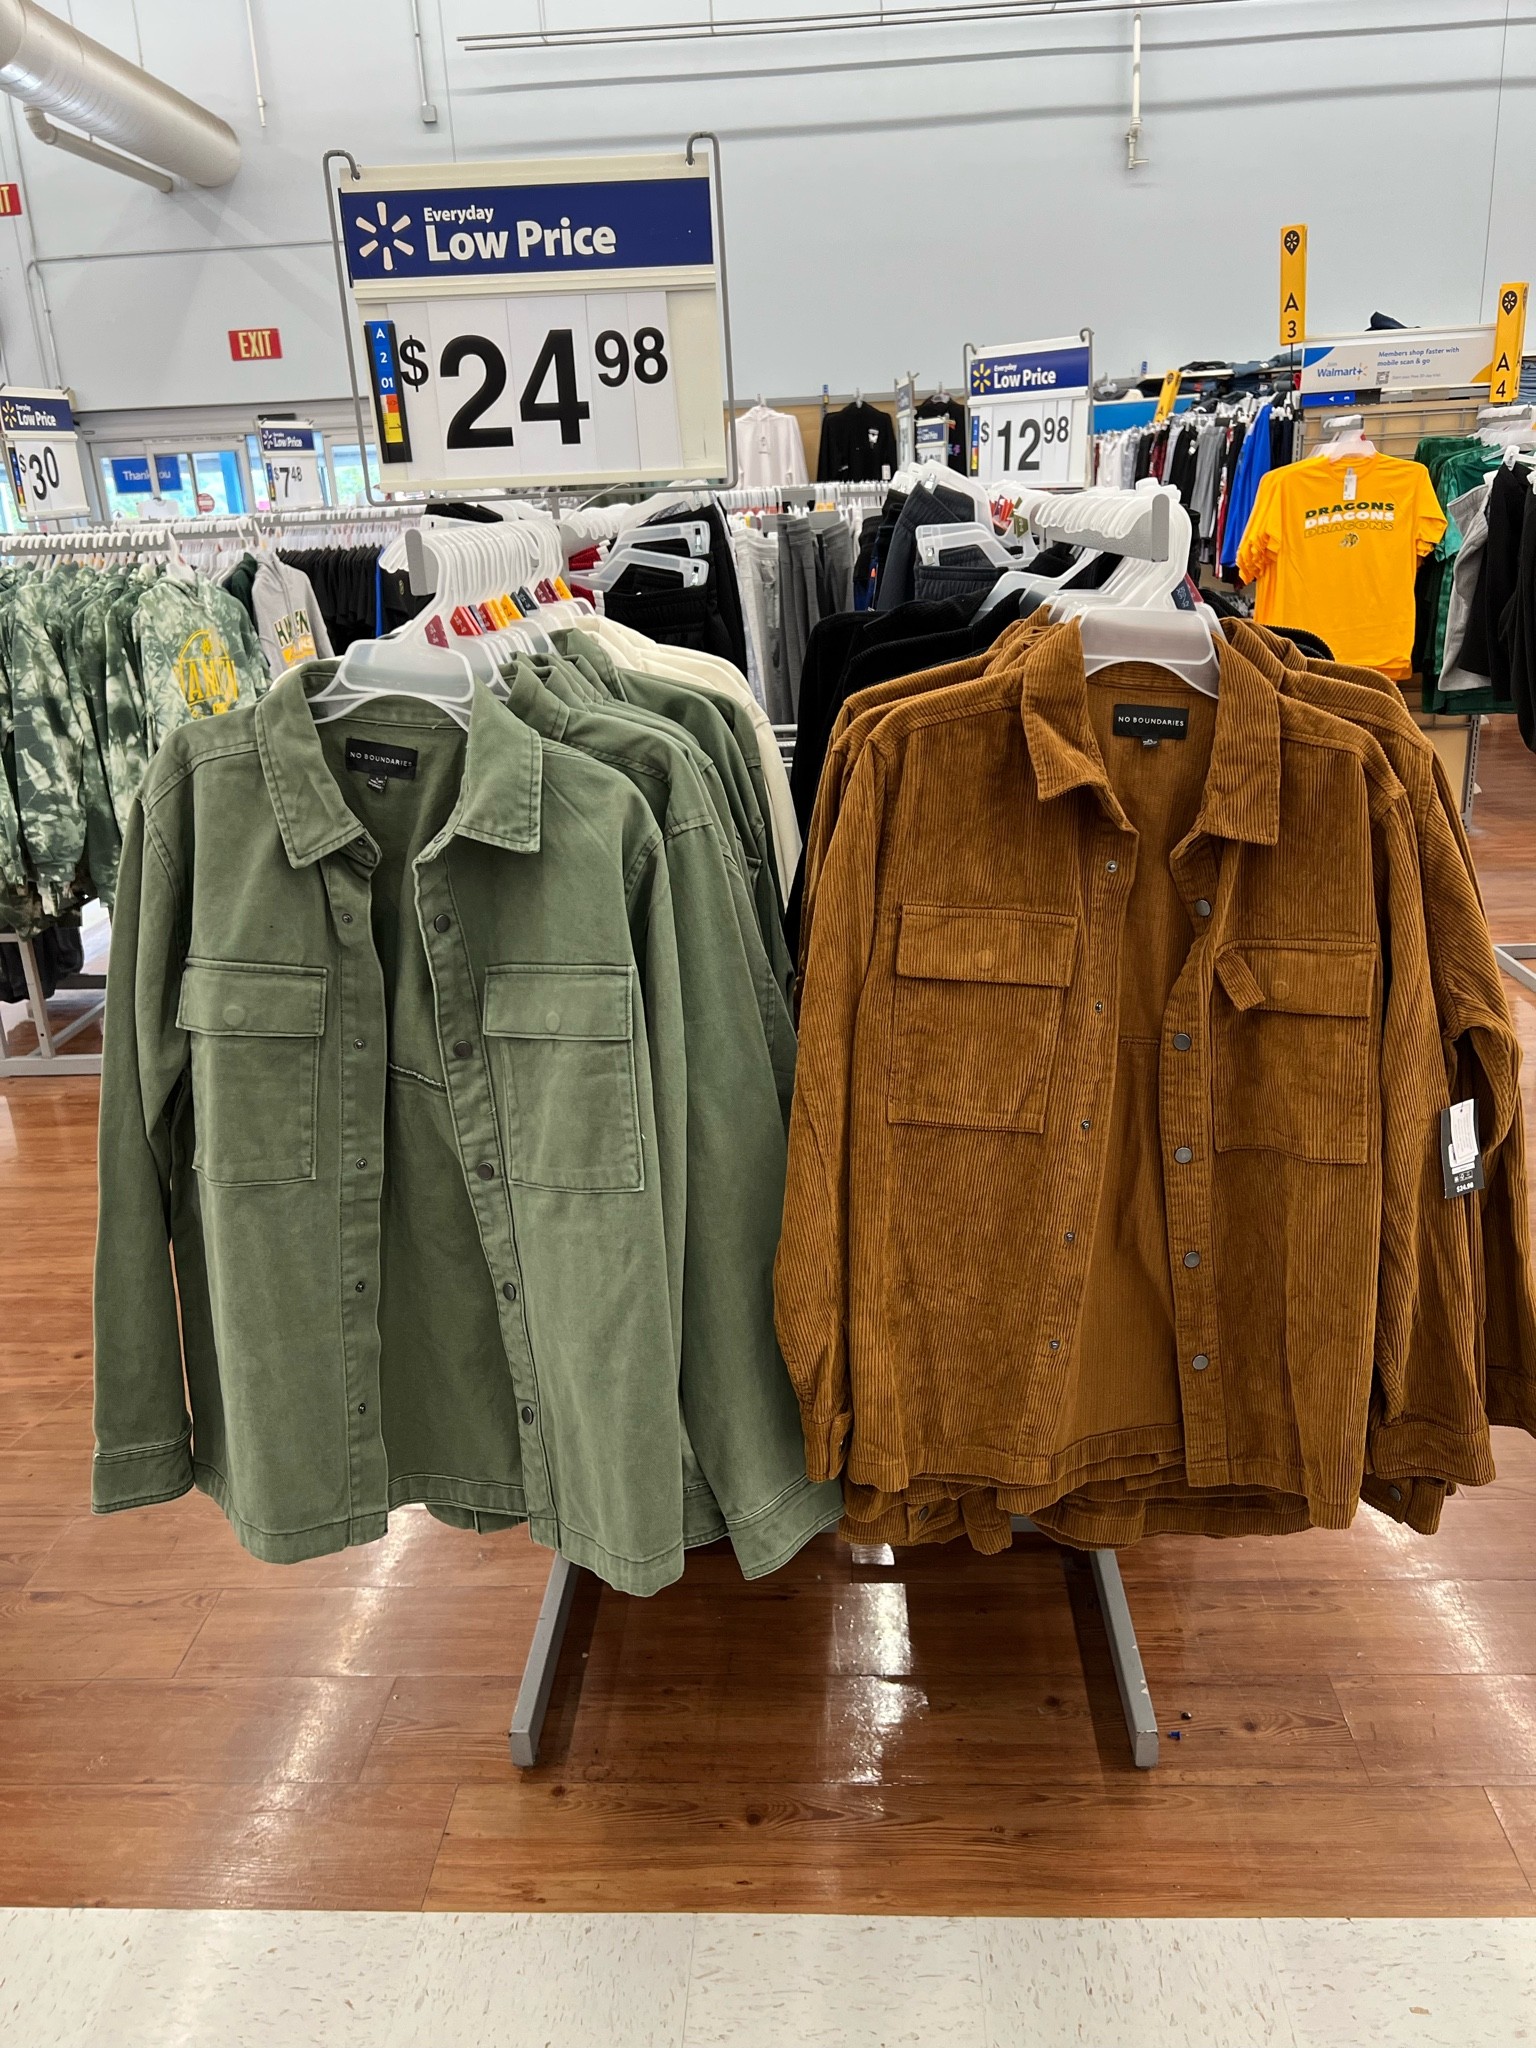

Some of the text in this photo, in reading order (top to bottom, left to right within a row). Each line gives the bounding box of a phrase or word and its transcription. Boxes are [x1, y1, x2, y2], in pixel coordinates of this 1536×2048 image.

[424, 205, 494, 223] Everyday
[425, 217, 617, 262] Low Price
[1284, 292, 1299, 313] A
[376, 327, 386, 339] A
[1287, 320, 1297, 338] 3
[239, 330, 272, 359] EXIT
[1378, 349, 1408, 358] Members
[1409, 348, 1424, 357] shop
[1426, 347, 1444, 355] faster
[380, 352, 388, 364] 2
[1377, 358, 1398, 367] mobile
[1496, 352, 1510, 372] A
[994, 367, 1056, 389] Low Price
[1496, 380, 1506, 398] 4
[17, 411, 57, 427] Low Price
[159, 470, 171, 480] ou
[1305, 501, 1395, 519] DRAGONS
[1304, 511, 1395, 529] DRAGONS
[1304, 521, 1394, 538] DRAGONS
[1133, 717, 1184, 727] BOUNDARIES
[349, 751, 362, 759] NO
